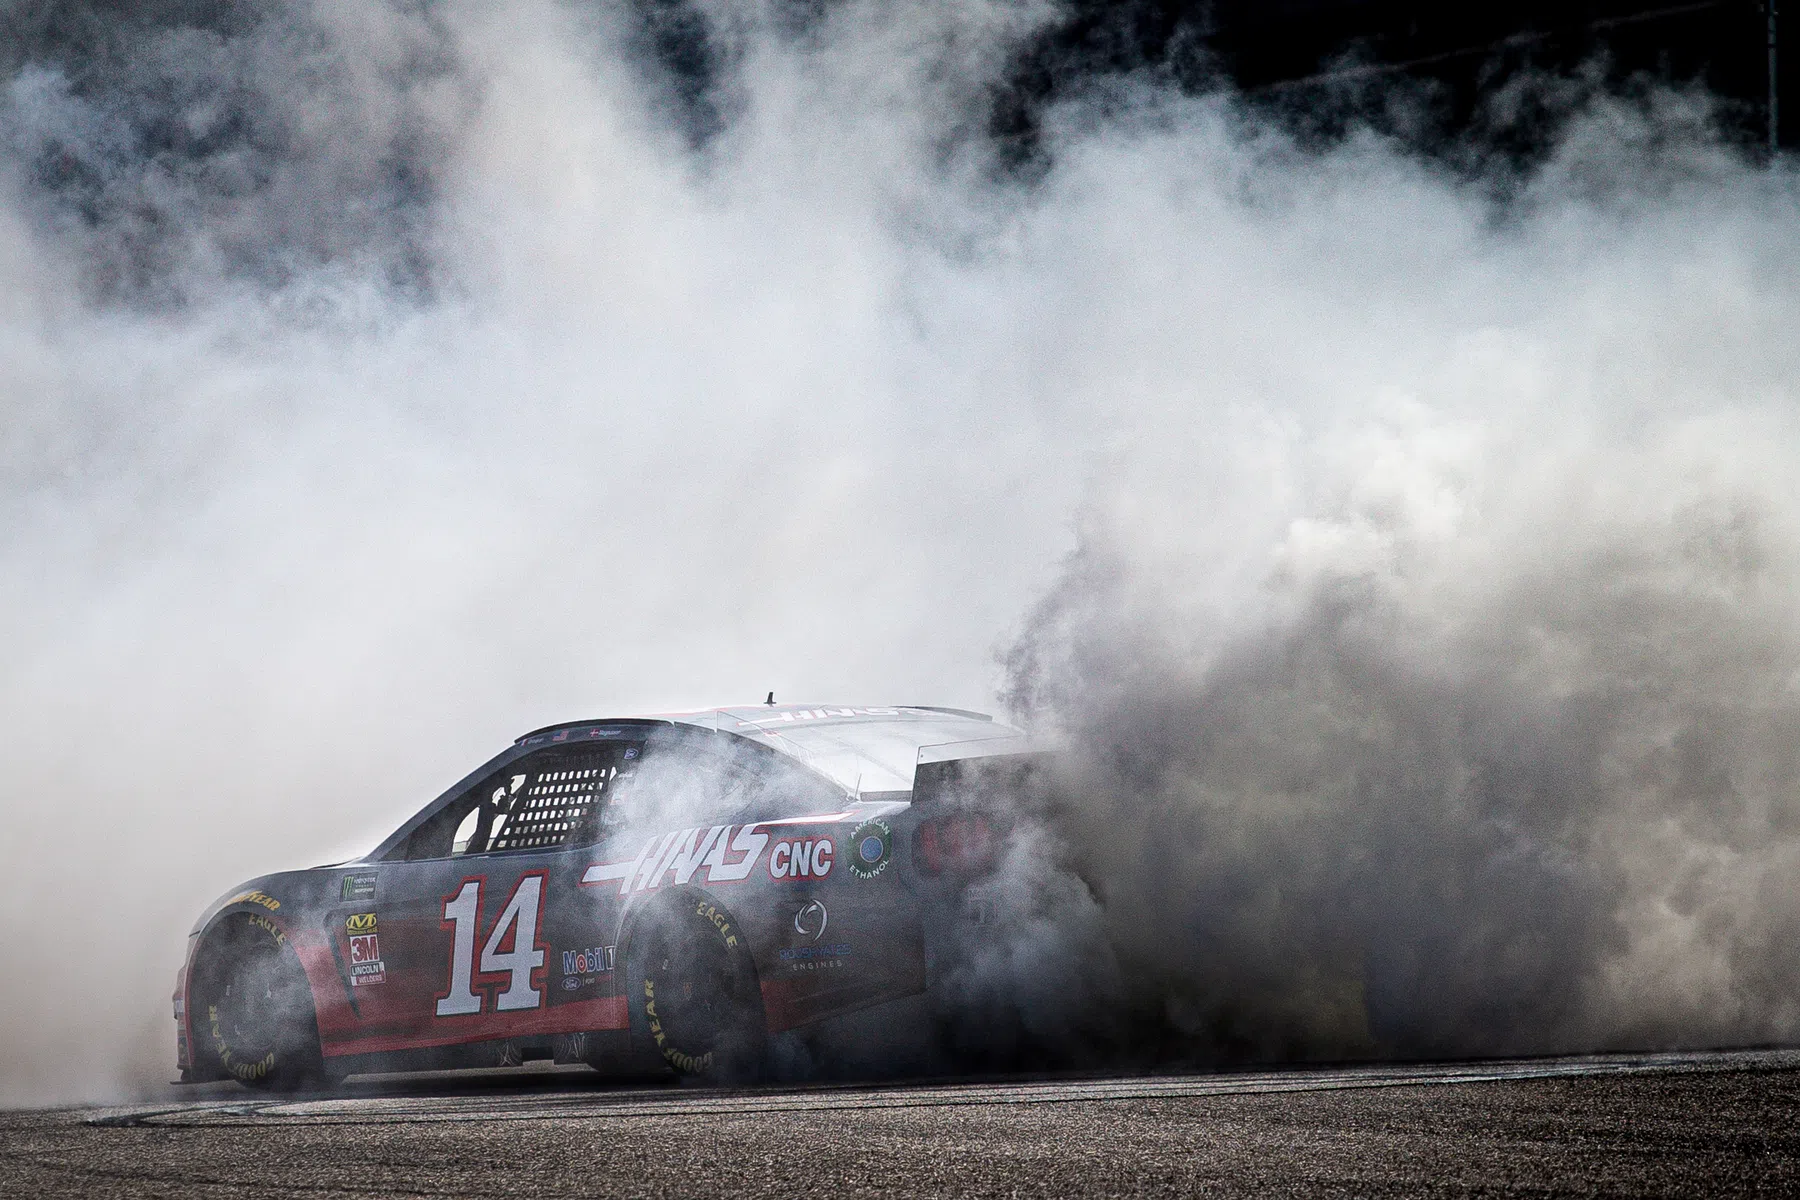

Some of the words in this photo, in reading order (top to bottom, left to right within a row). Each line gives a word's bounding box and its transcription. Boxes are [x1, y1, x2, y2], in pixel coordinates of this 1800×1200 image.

[850, 818, 890, 839] AMERICAN
[581, 824, 769, 895] HAAS
[769, 837, 833, 880] CNC
[849, 859, 889, 879] ETHANOL
[248, 912, 286, 947] EAGLE
[696, 900, 738, 949] EAGLE
[351, 936, 379, 962] 3M
[436, 869, 548, 1018] 14
[351, 964, 379, 975] LINCOLN
[562, 946, 605, 975] Mobil
[792, 959, 843, 971] ENGINES
